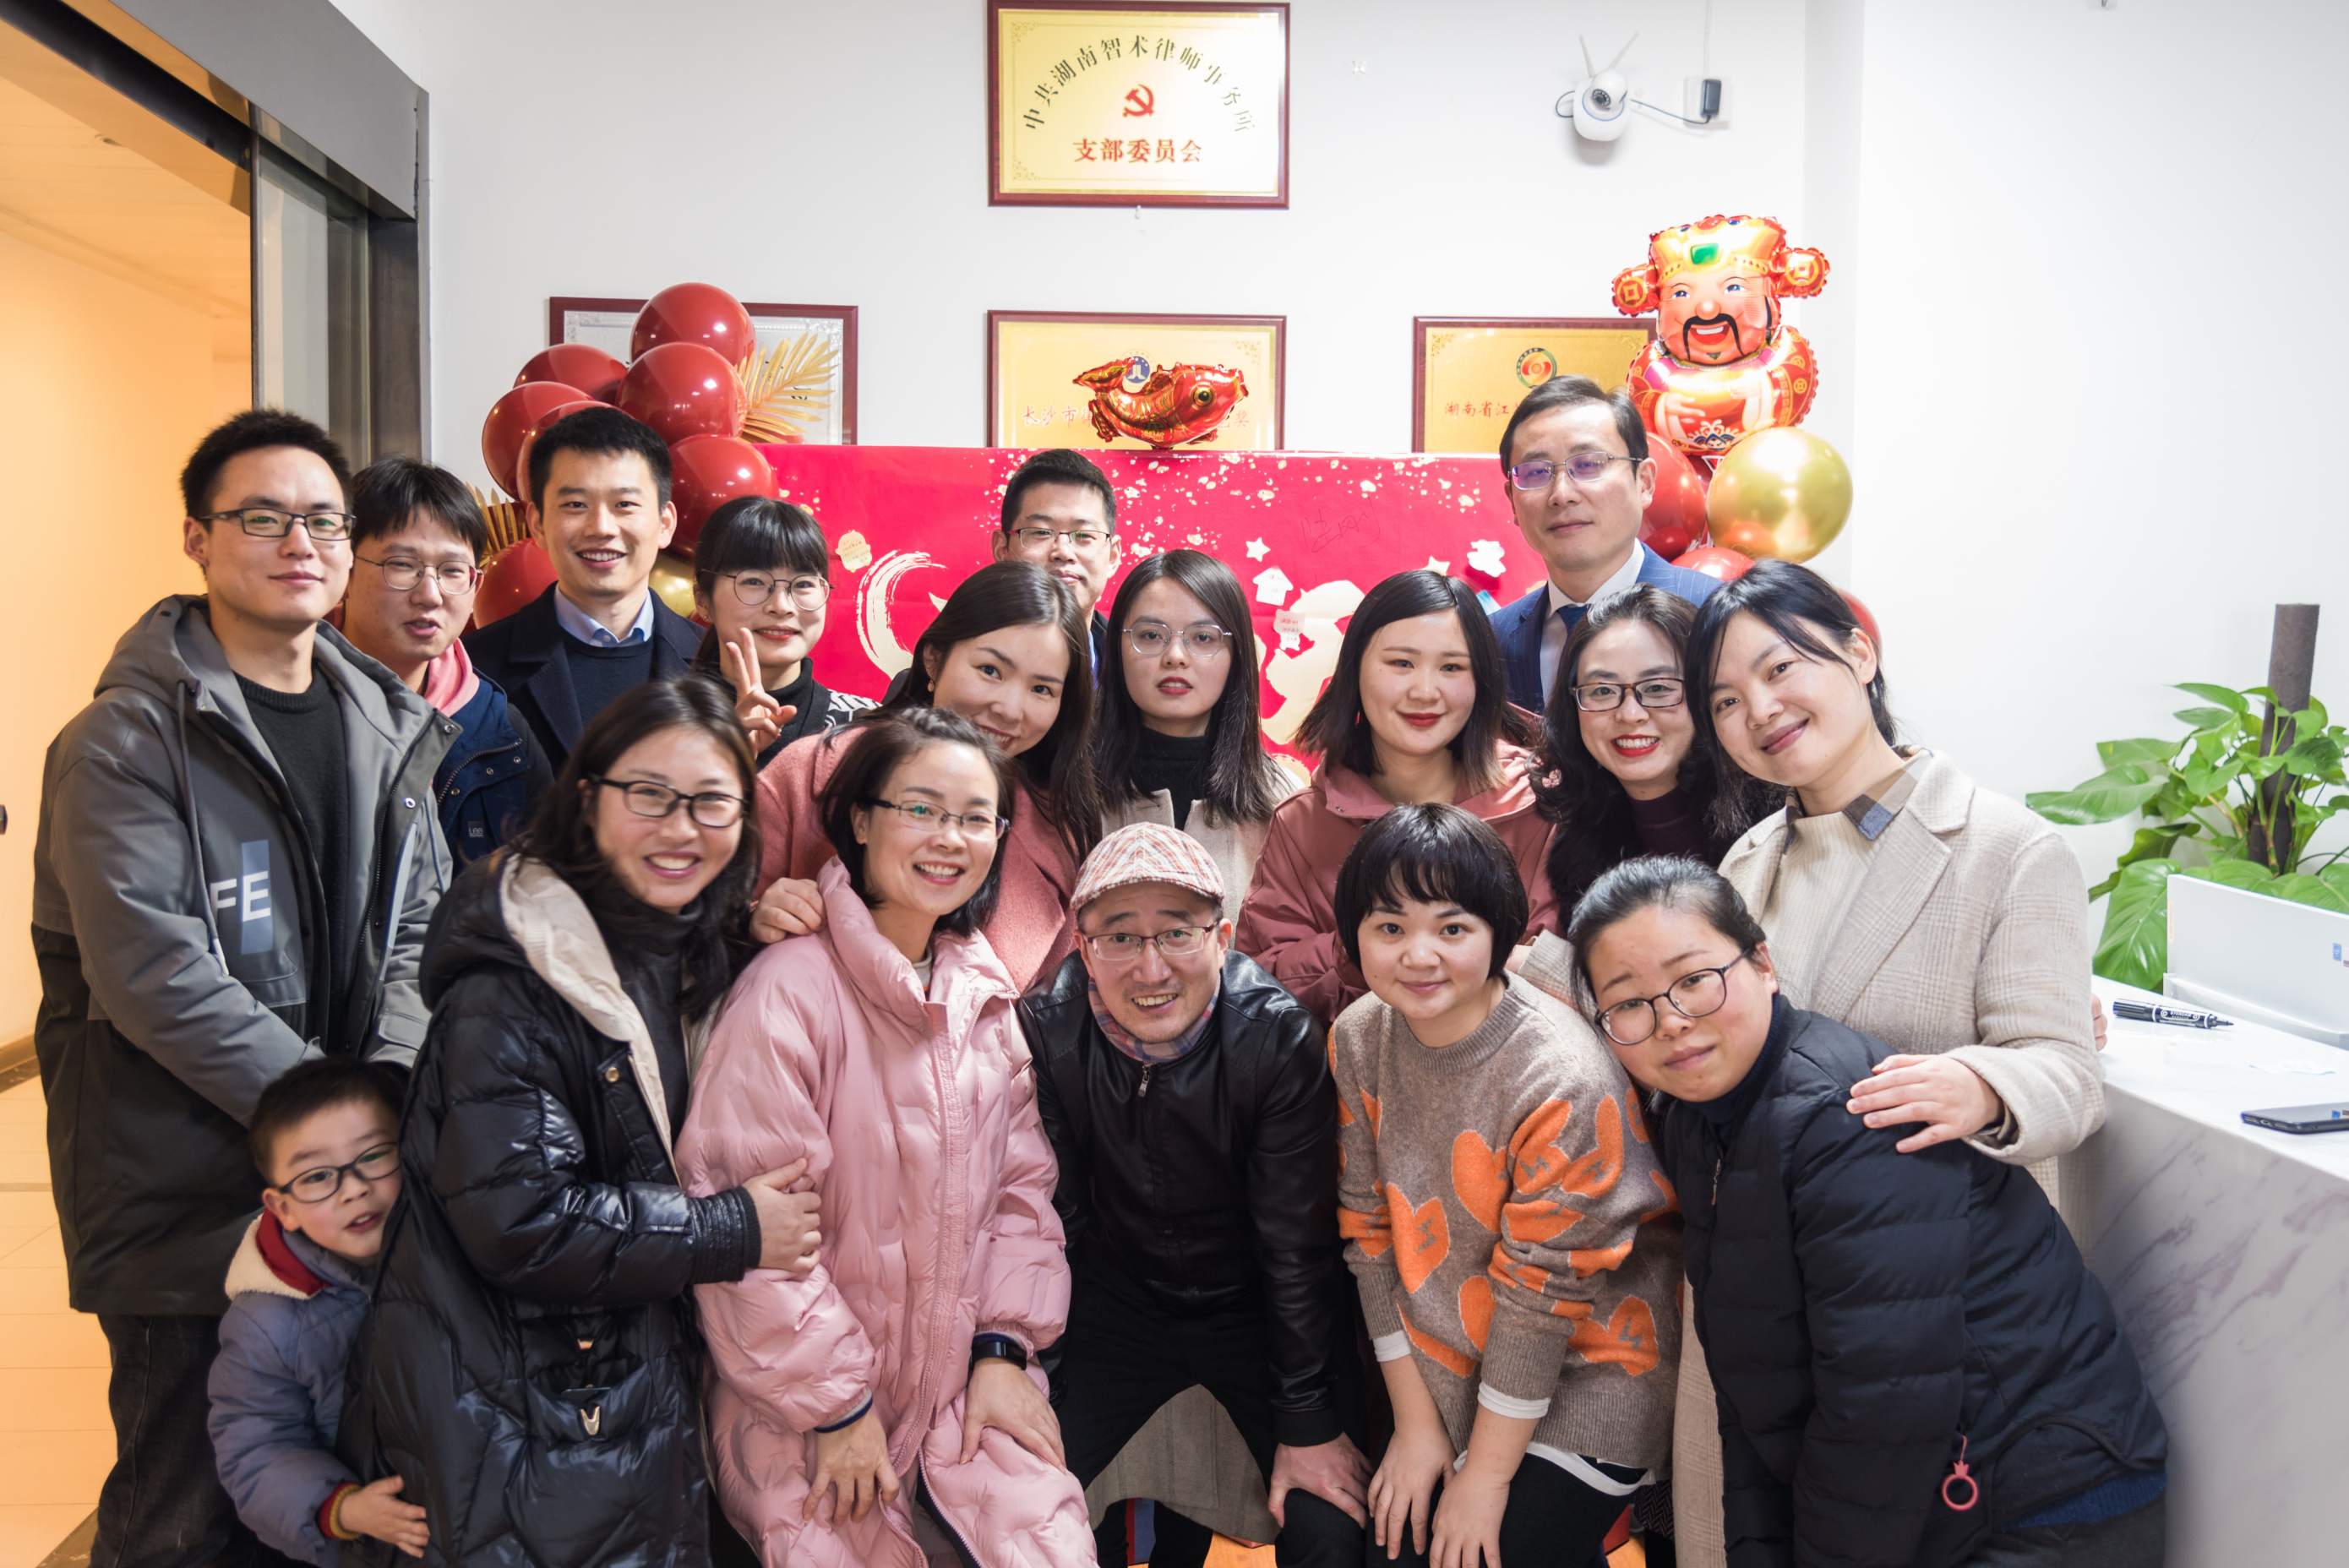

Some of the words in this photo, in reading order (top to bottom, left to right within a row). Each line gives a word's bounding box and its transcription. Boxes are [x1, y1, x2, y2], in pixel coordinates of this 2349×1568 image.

[1073, 139, 1202, 163] 支部委员会
[1444, 401, 1518, 418] 湖南省江
